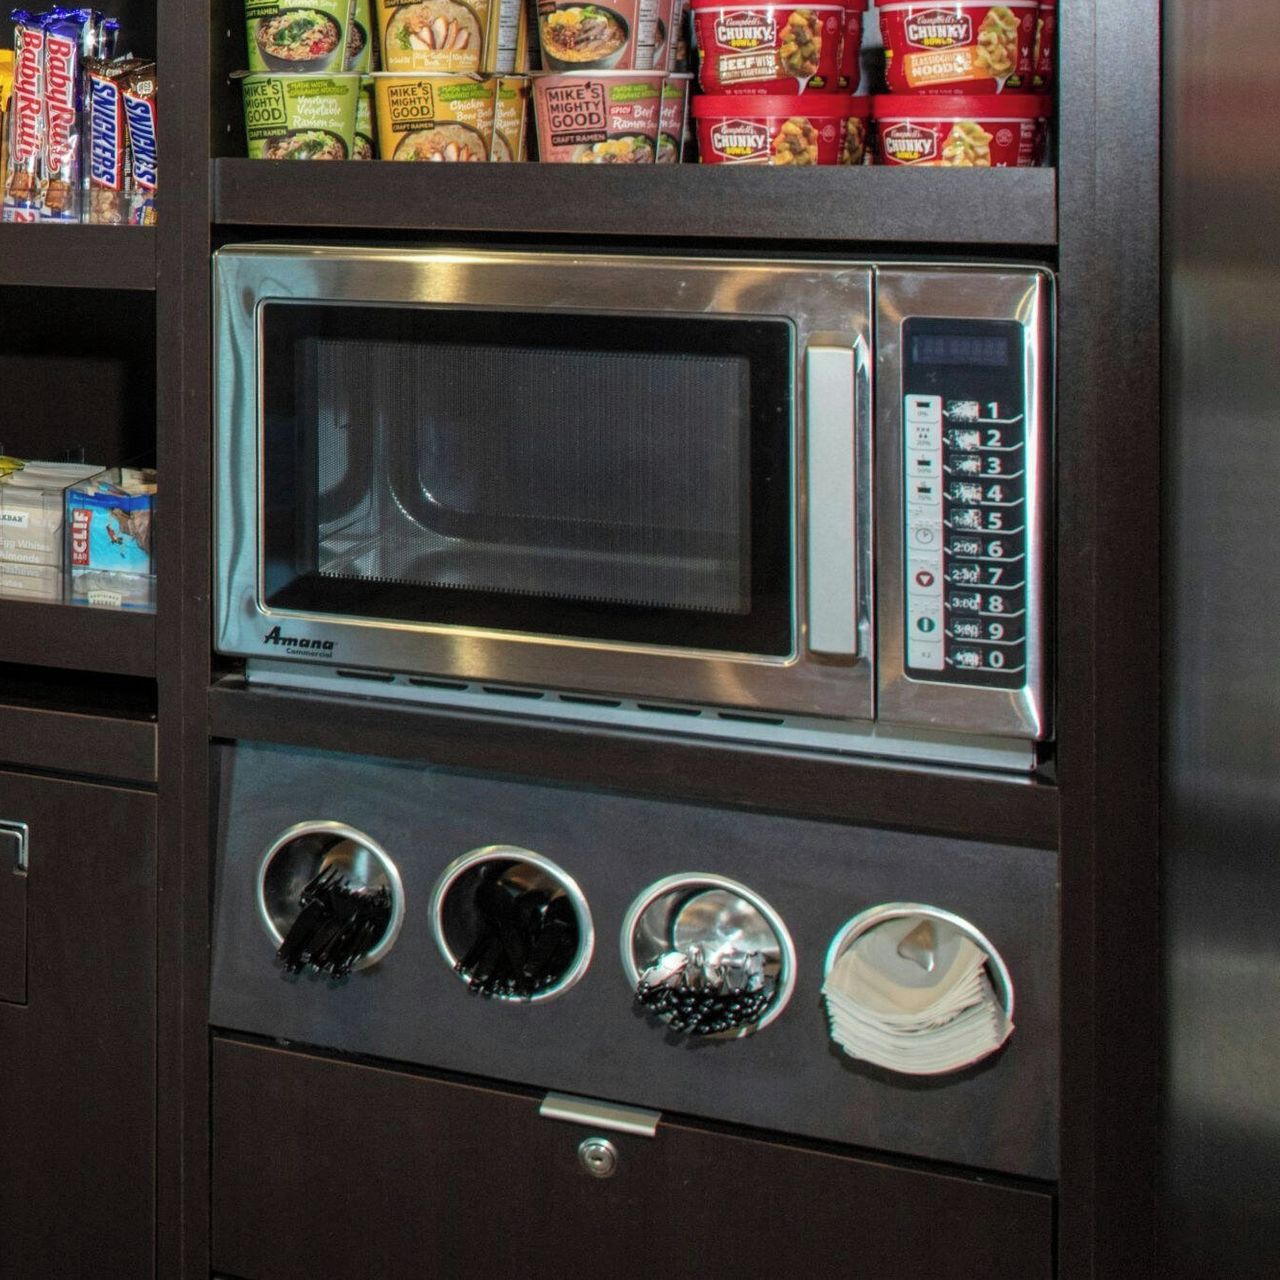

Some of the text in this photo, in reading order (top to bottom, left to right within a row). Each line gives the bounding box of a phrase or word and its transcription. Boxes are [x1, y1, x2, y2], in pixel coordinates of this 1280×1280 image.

[718, 26, 772, 41] CHUNKY
[908, 24, 968, 40] CHUNKY
[720, 57, 755, 71] BEEF
[244, 84, 280, 96] MIKE'S
[390, 86, 430, 98] MIKE'S
[548, 86, 601, 101] MIKE'S
[246, 97, 281, 107] MIGHTY
[392, 96, 430, 106] MIGHTY
[550, 100, 601, 114] MIGHTY
[247, 108, 282, 122] GOOD
[393, 105, 431, 118] GOOD
[292, 116, 327, 128] Ramen
[552, 112, 602, 128] GOOD
[92, 80, 116, 184] SNICKERS
[575, 133, 606, 143] RAMEN
[125, 97, 158, 185] SNICKES
[713, 134, 765, 148] CHUNKY
[885, 138, 933, 153] CHUNKY
[988, 402, 998, 419] 1
[987, 429, 1001, 446] 2
[987, 457, 1001, 474] 3
[987, 485, 1003, 502] 4
[988, 512, 1002, 530] 5
[73, 509, 89, 551] CLIF
[0, 538, 49, 550] Egg Whites
[988, 541, 1003, 557] 6
[0, 551, 40, 563] Almonds
[73, 551, 88, 560] BAR
[988, 568, 1003, 585] 7
[988, 595, 1003, 612] 8
[264, 626, 334, 650] Amana
[989, 623, 1004, 640] 9
[287, 647, 333, 658] Commercial
[989, 650, 1004, 668] 0
